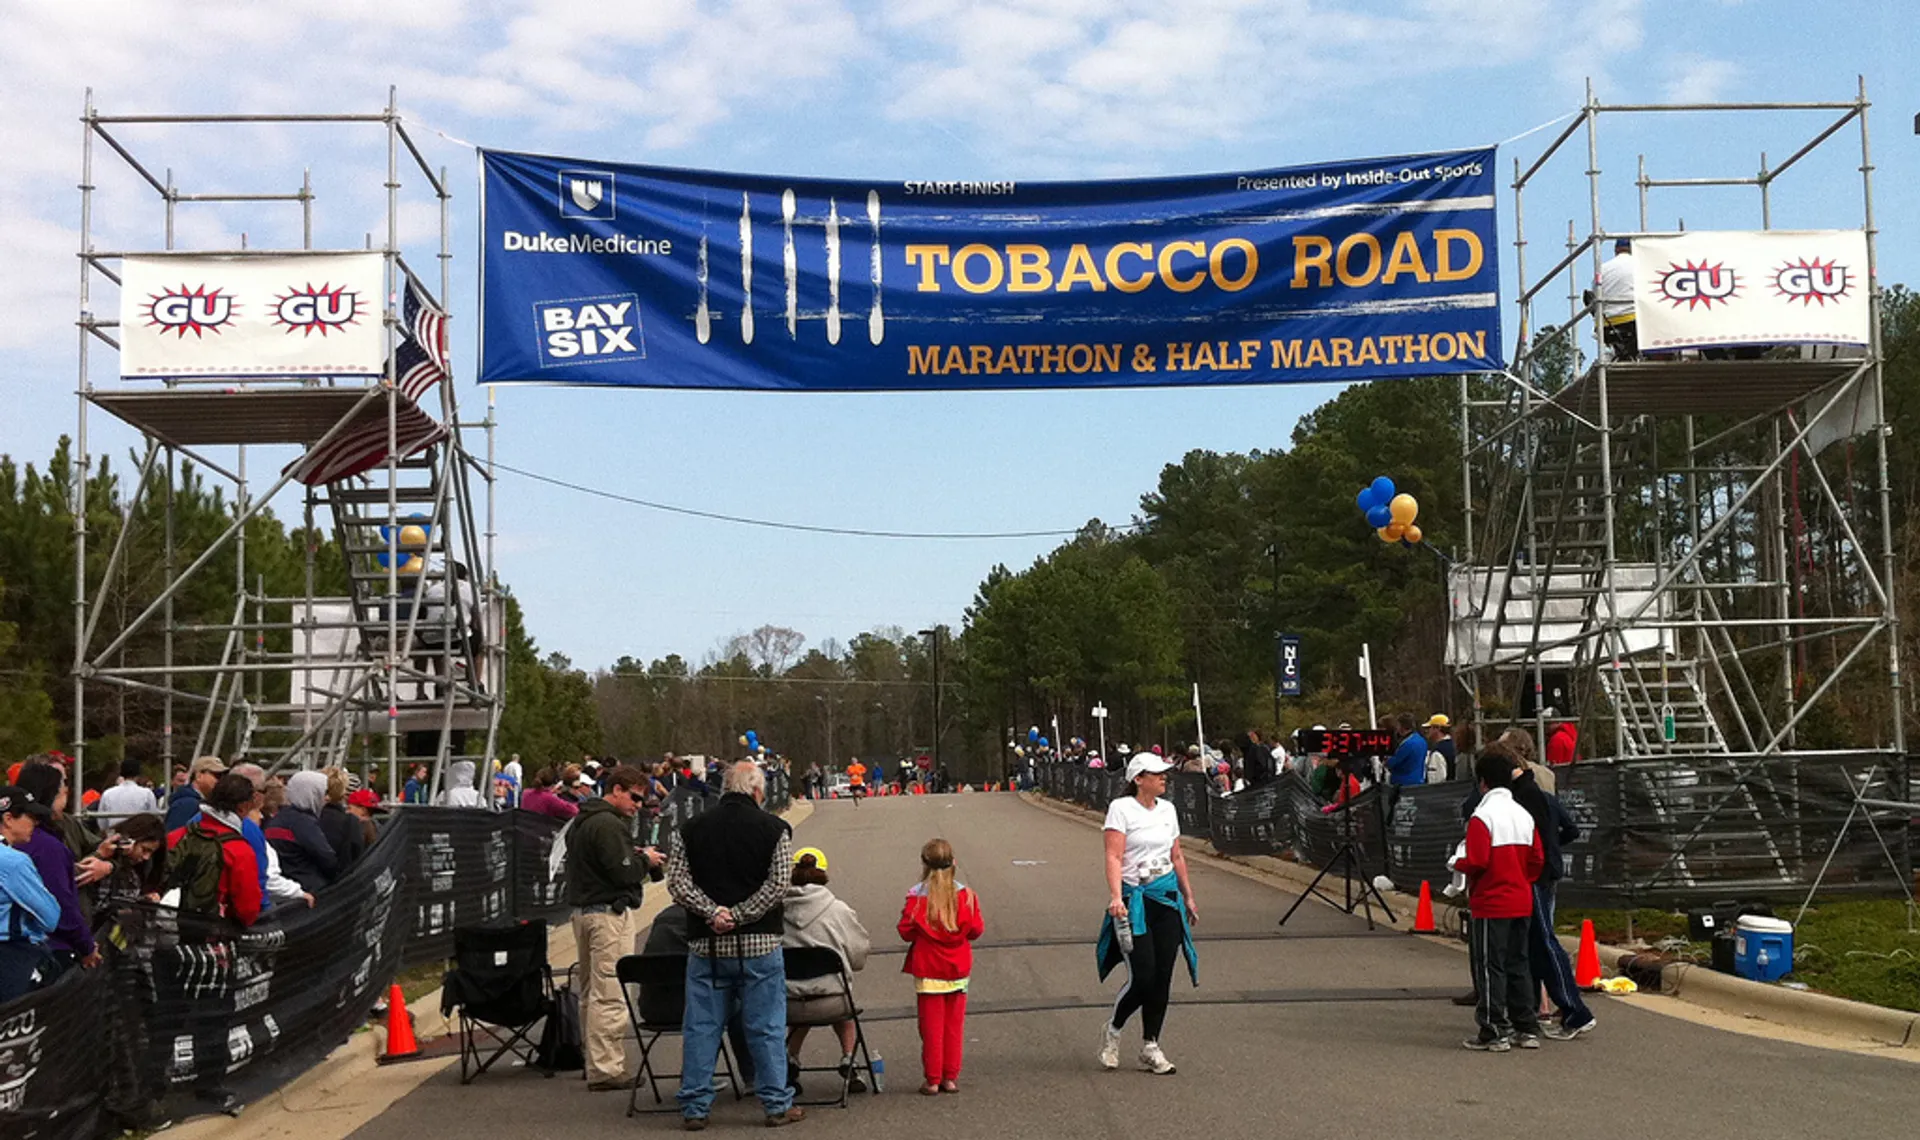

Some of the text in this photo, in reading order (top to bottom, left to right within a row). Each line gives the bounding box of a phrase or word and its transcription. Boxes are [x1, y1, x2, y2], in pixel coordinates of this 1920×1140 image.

[903, 180, 1015, 195] START-FINISH
[1237, 161, 1483, 190] Presented by Inside-Out Sports
[504, 231, 672, 255] DukeMedicine
[905, 228, 1483, 294] TOBACCO ROAD
[1662, 268, 1736, 300] GU
[1776, 266, 1847, 296] GU
[152, 294, 232, 327] GU
[277, 293, 356, 326] GU
[543, 302, 632, 331] BAY
[548, 326, 637, 358] SIX
[907, 331, 1486, 375] MARATHON & HALF MARATHON
